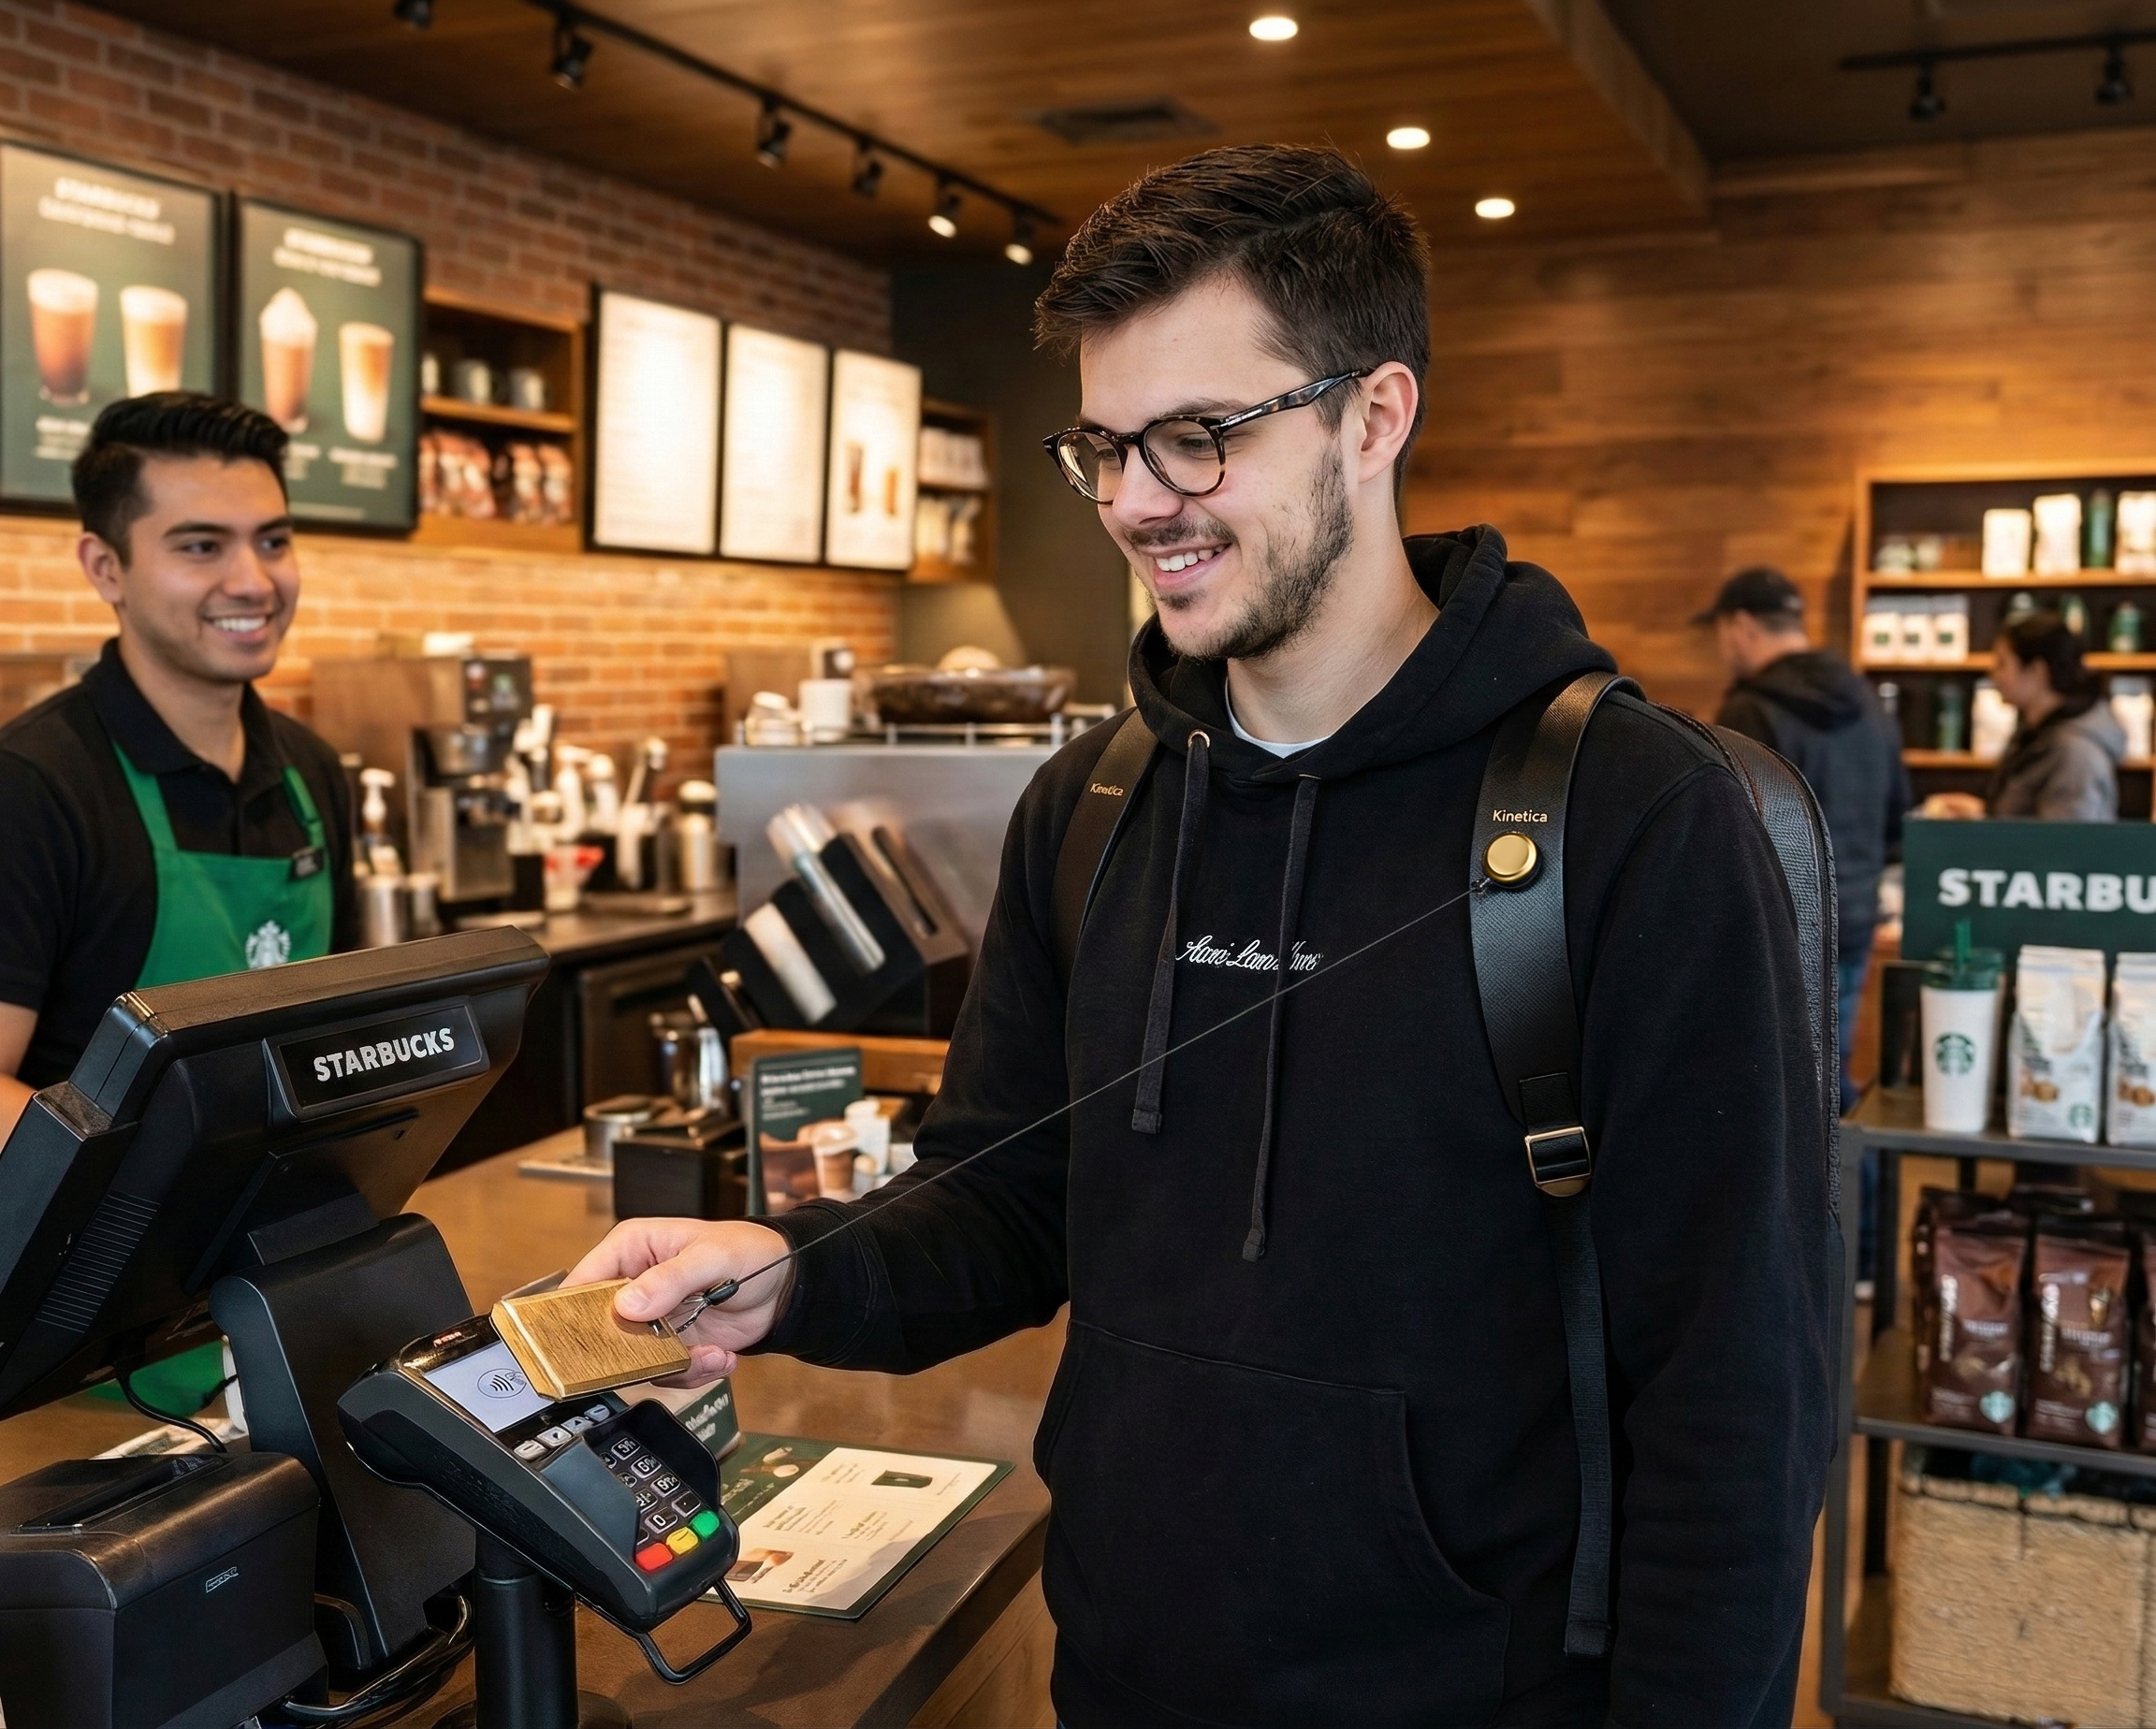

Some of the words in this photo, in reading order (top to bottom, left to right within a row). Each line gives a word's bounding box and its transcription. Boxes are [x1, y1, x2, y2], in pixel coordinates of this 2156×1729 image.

[1493, 809, 1548, 822] Kinetica
[313, 1027, 455, 1082] STARBUCKS
[652, 1514, 666, 1526] 0
